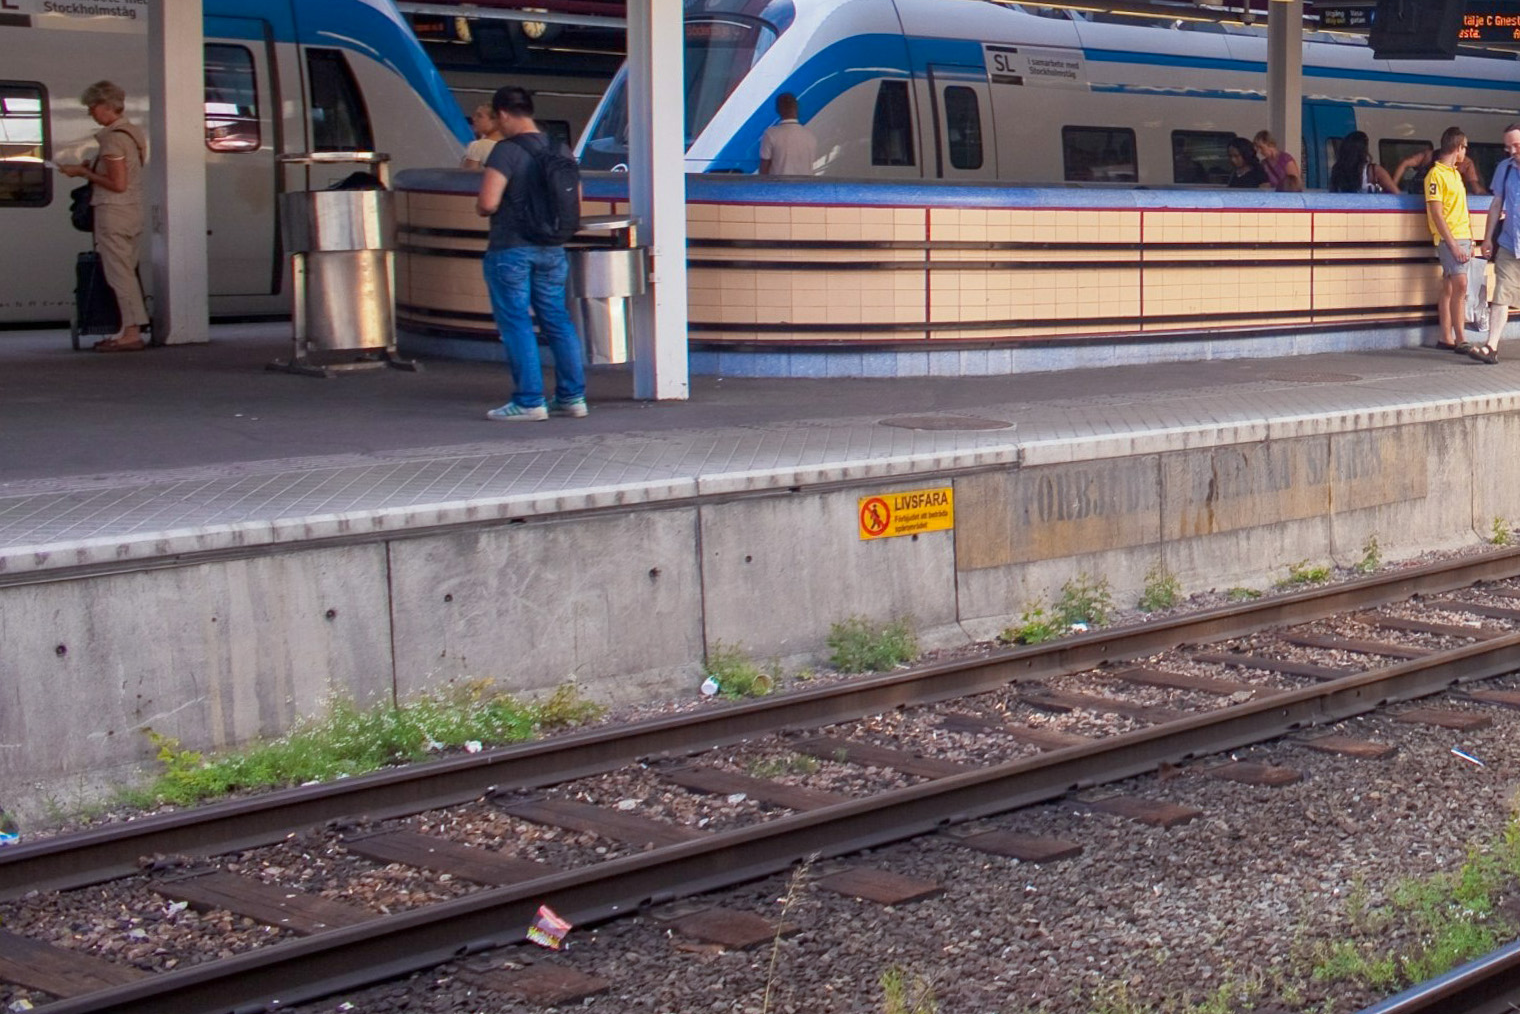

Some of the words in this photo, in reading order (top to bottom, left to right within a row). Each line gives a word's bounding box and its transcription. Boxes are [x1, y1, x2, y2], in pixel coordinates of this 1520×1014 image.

[44, 0, 136, 19] Stockholmståg
[1486, 15, 1493, 26] C
[993, 53, 1016, 73] SL
[895, 492, 949, 511] LIVSFARA
[895, 514, 920, 523] Förbjudet
